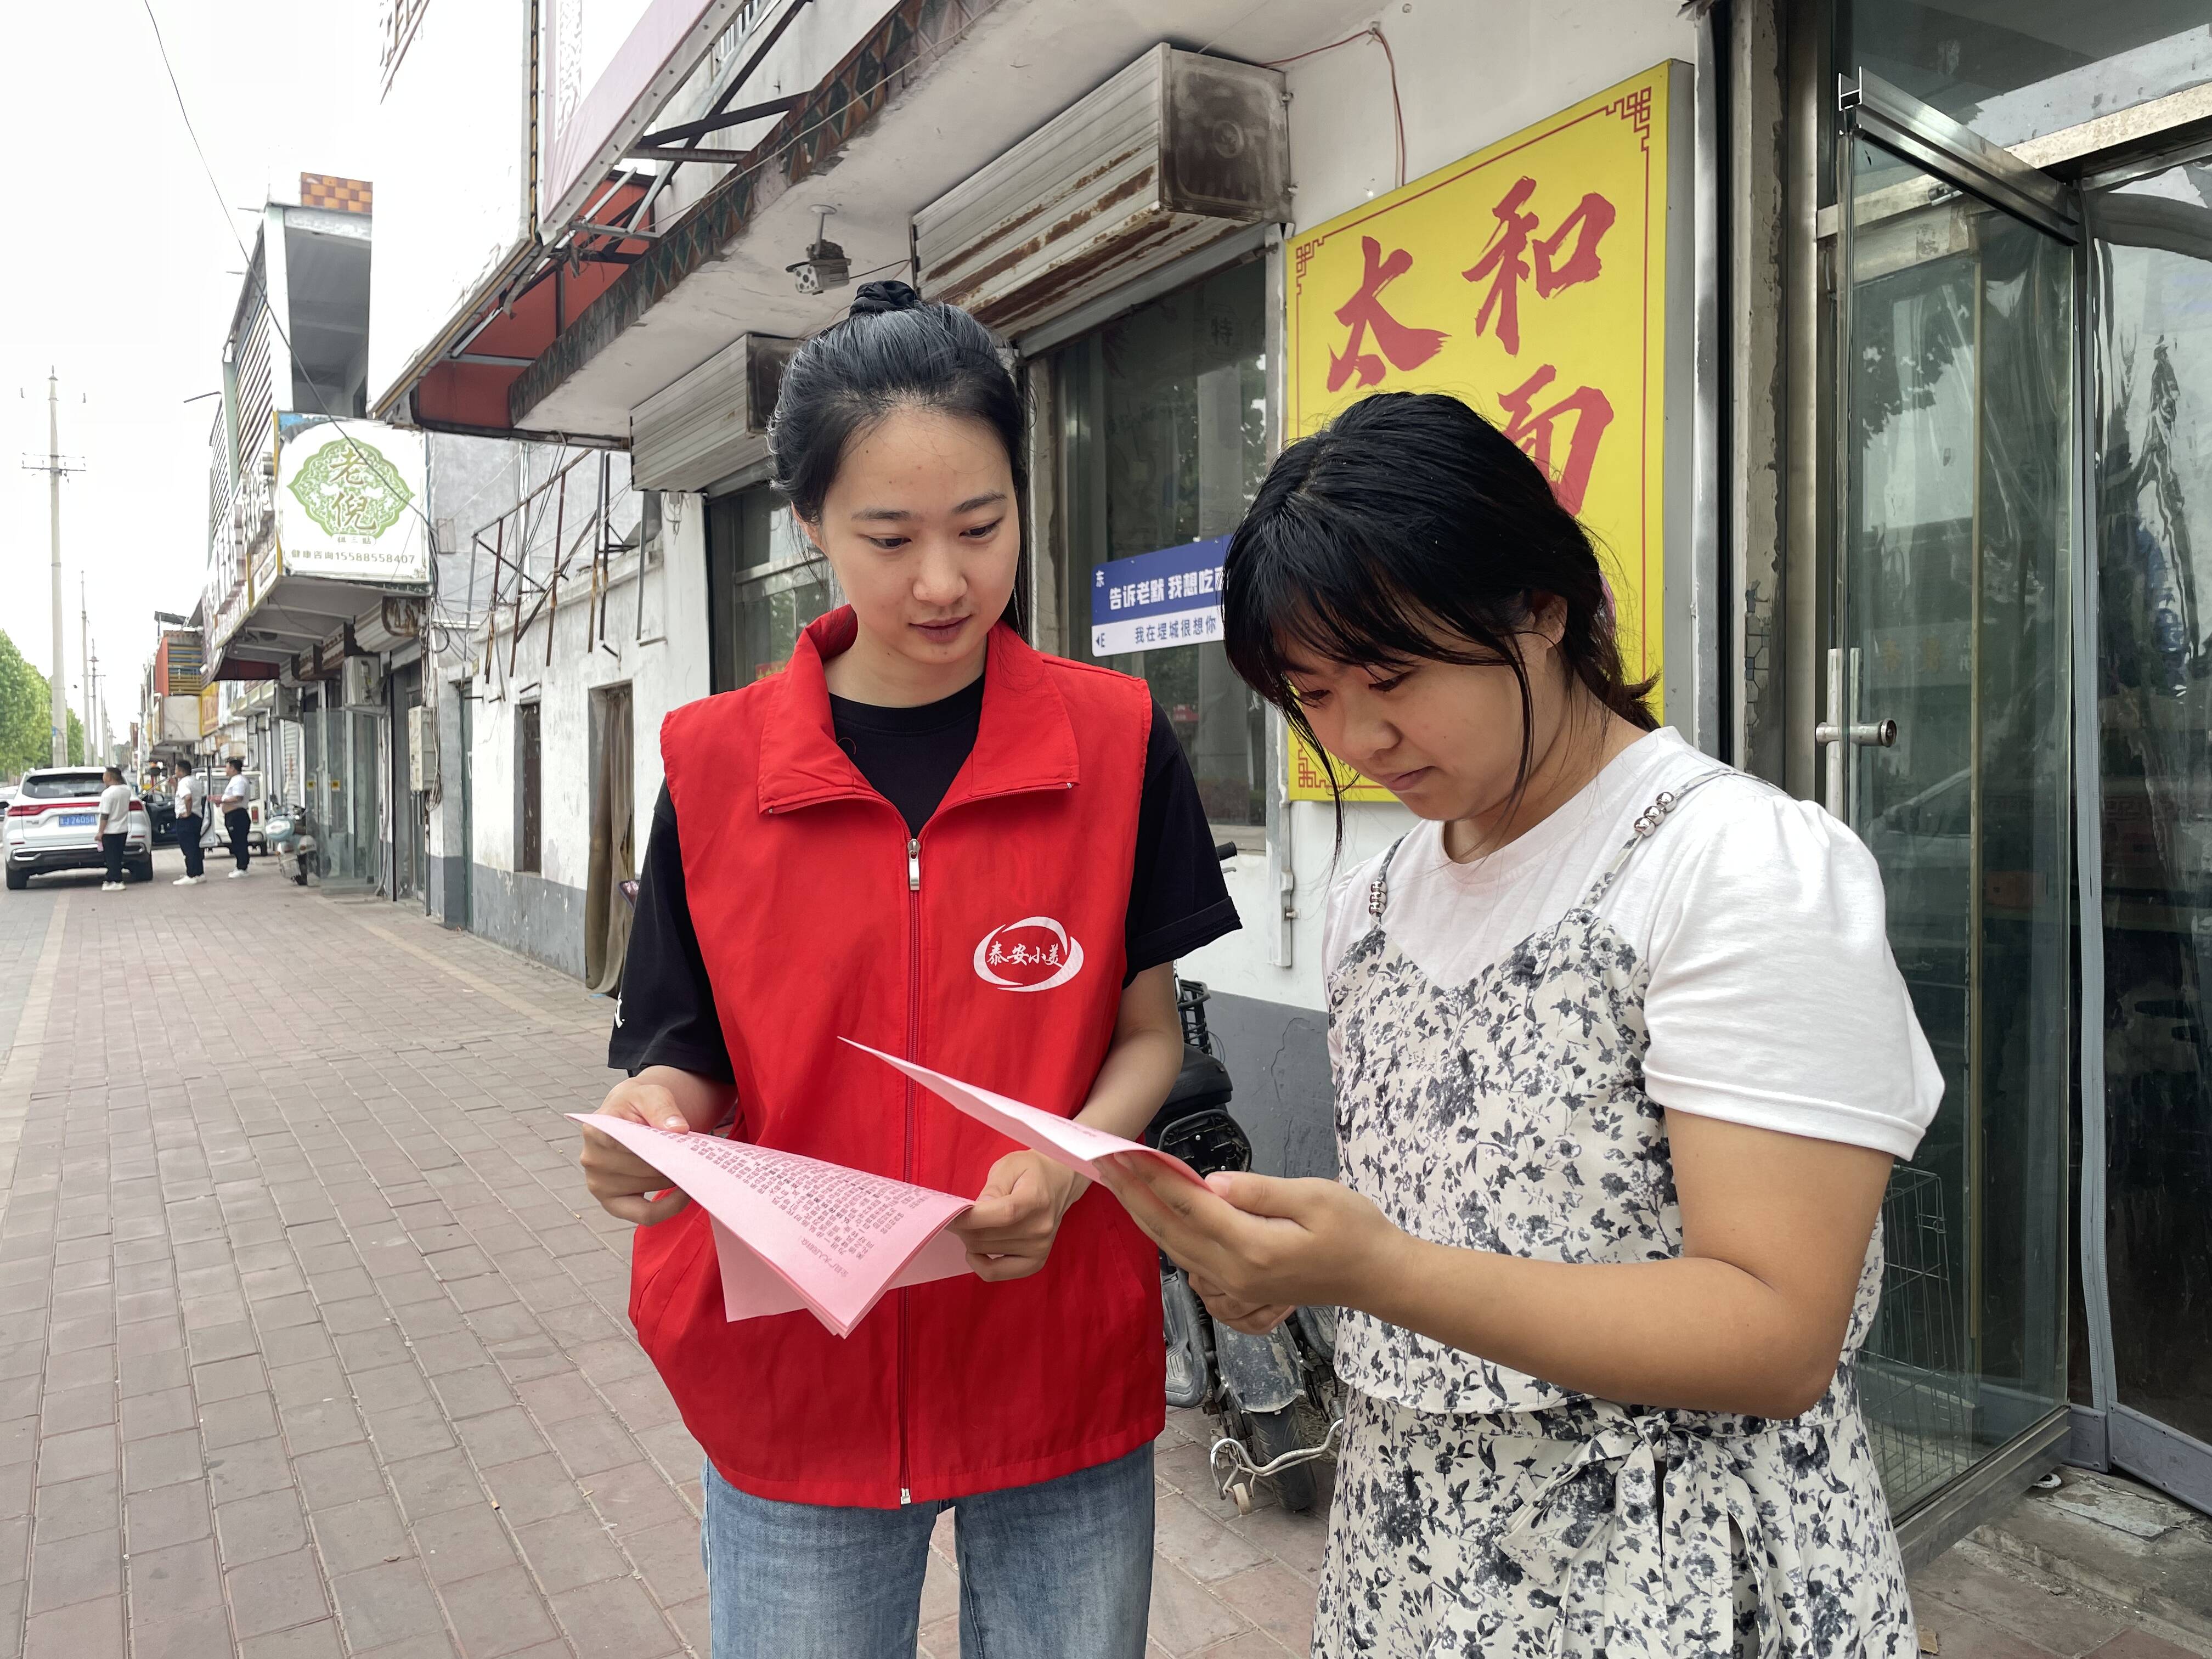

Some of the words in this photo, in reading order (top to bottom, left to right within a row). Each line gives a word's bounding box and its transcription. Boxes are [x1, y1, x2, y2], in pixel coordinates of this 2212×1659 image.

[1327, 176, 1616, 393] 太和
[1109, 578, 1165, 611] 告诉老默
[986, 941, 1063, 968] 泰安小美
